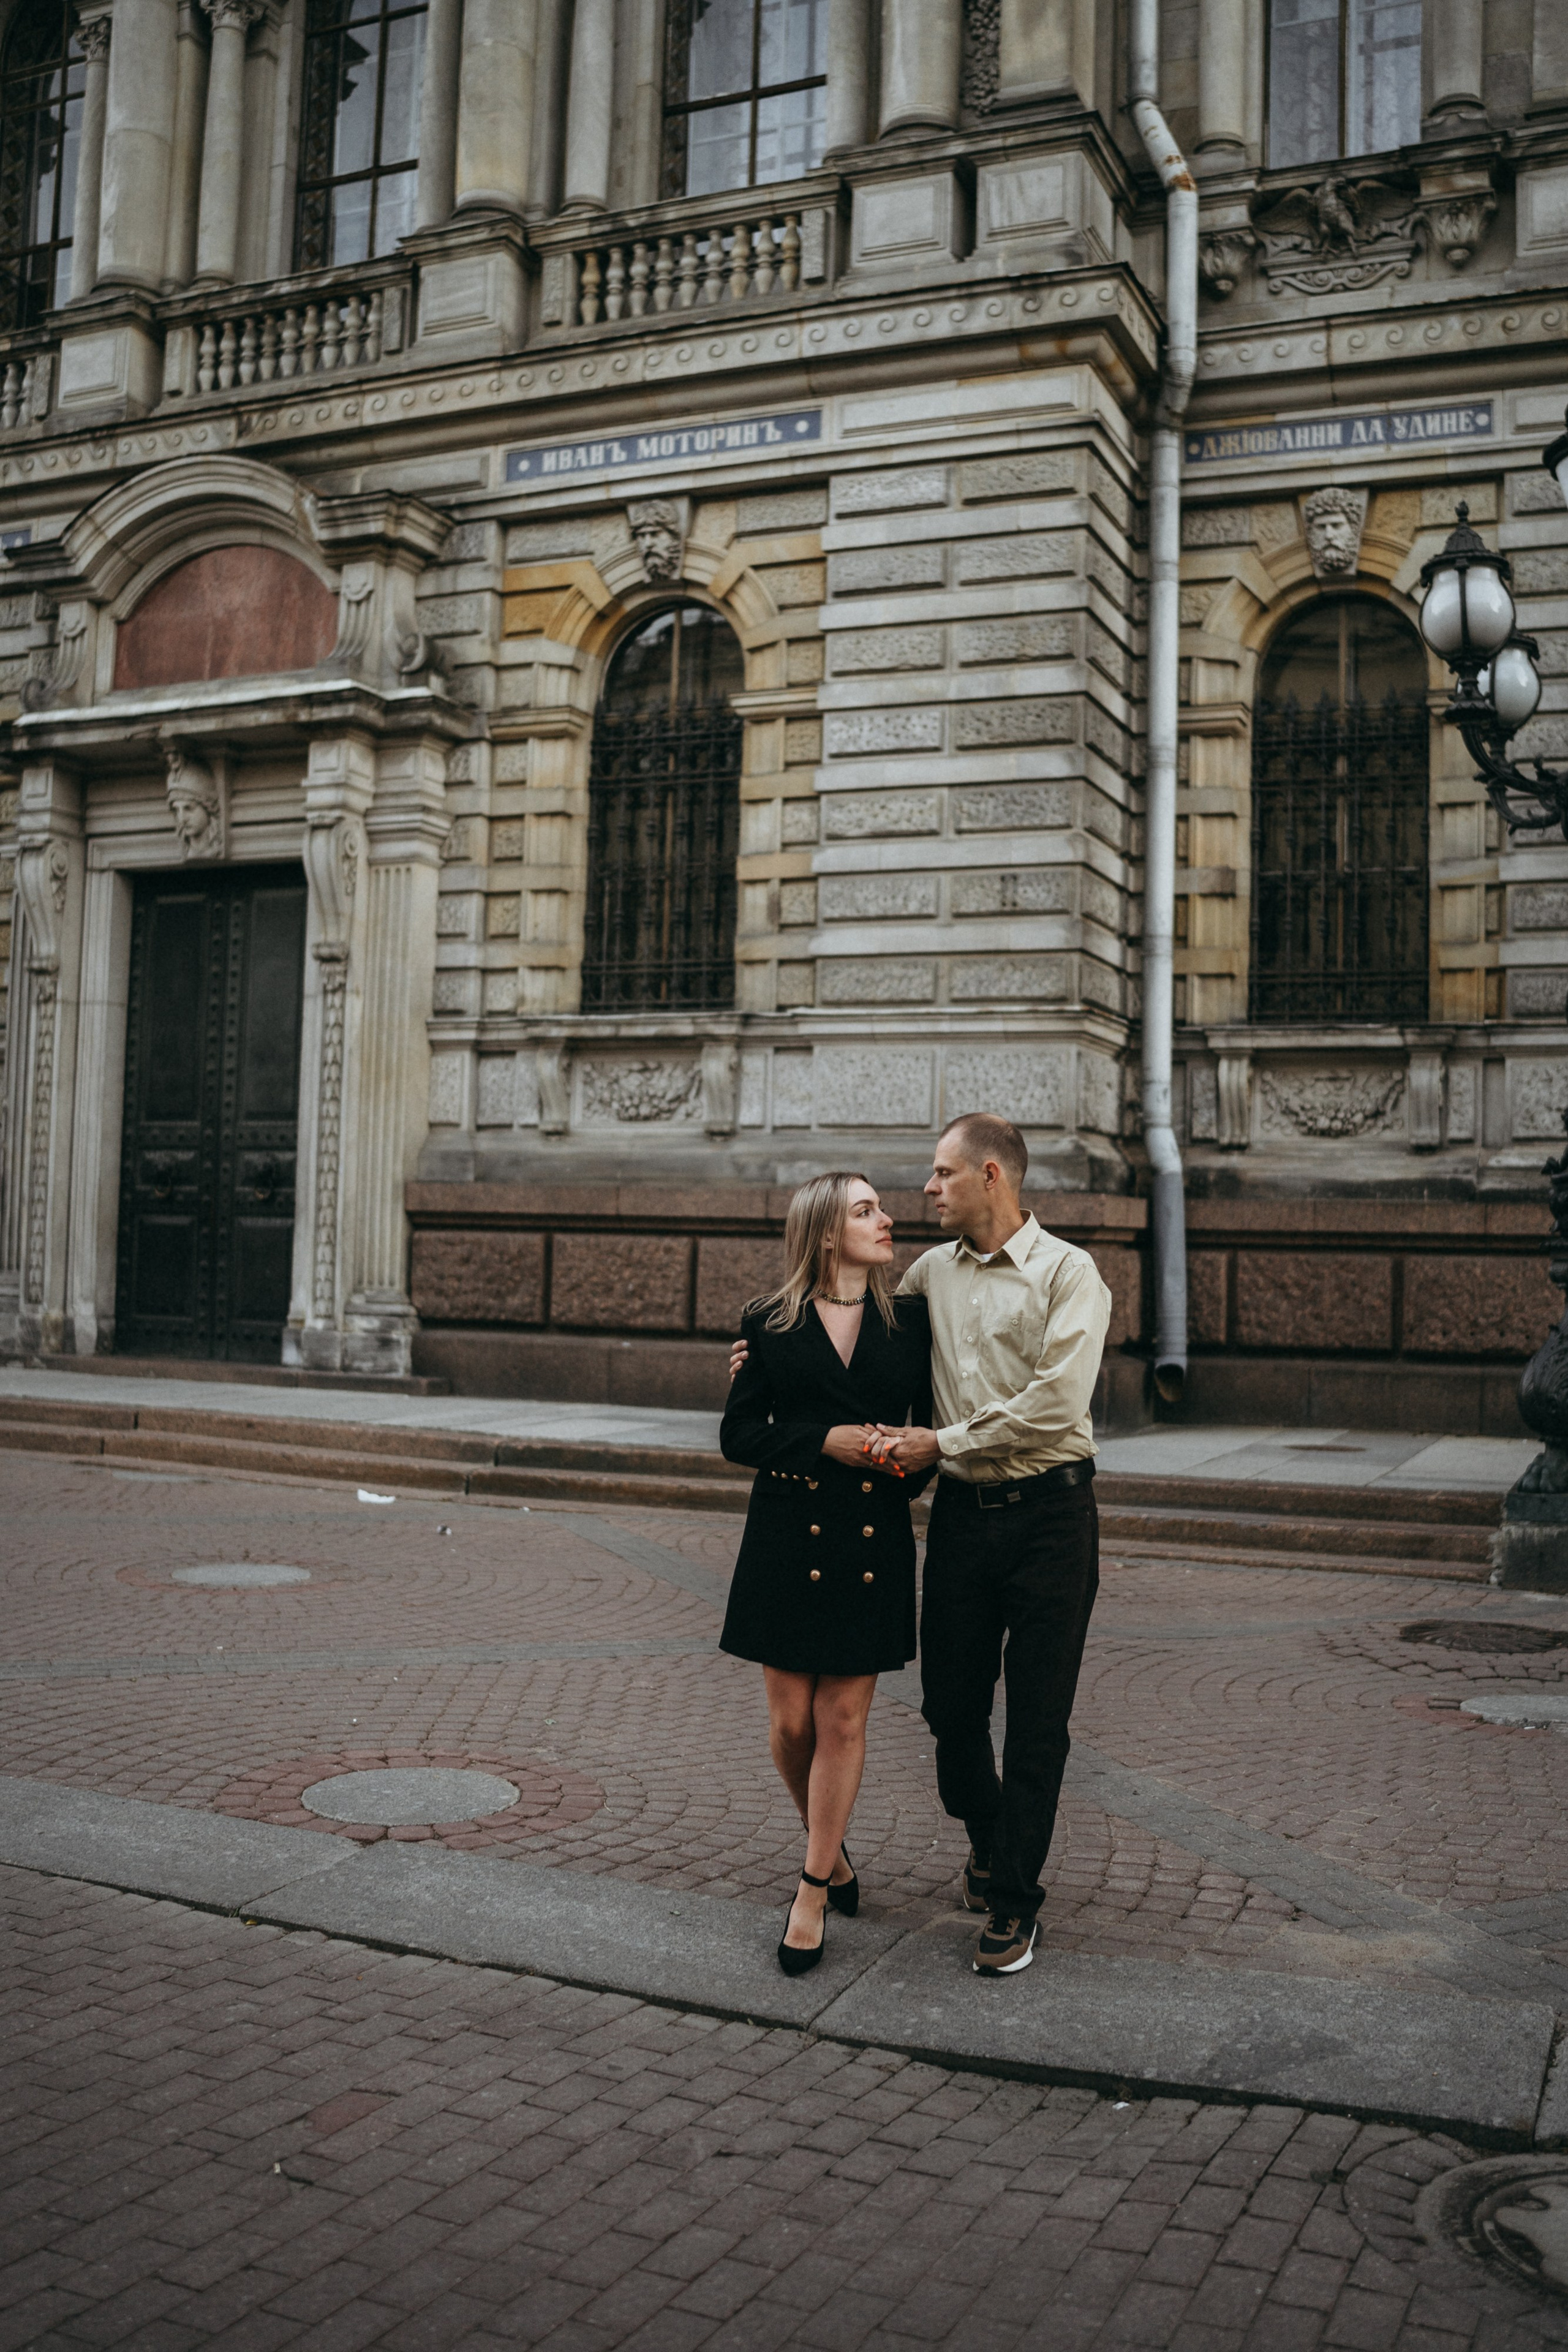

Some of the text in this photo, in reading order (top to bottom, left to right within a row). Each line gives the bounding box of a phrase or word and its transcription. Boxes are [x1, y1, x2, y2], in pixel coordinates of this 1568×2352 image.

[542, 421, 782, 472] ИВАНЪ МОТОРИНЪ
[1351, 419, 1386, 445] ДА
[1392, 410, 1475, 440] УДИНЕ
